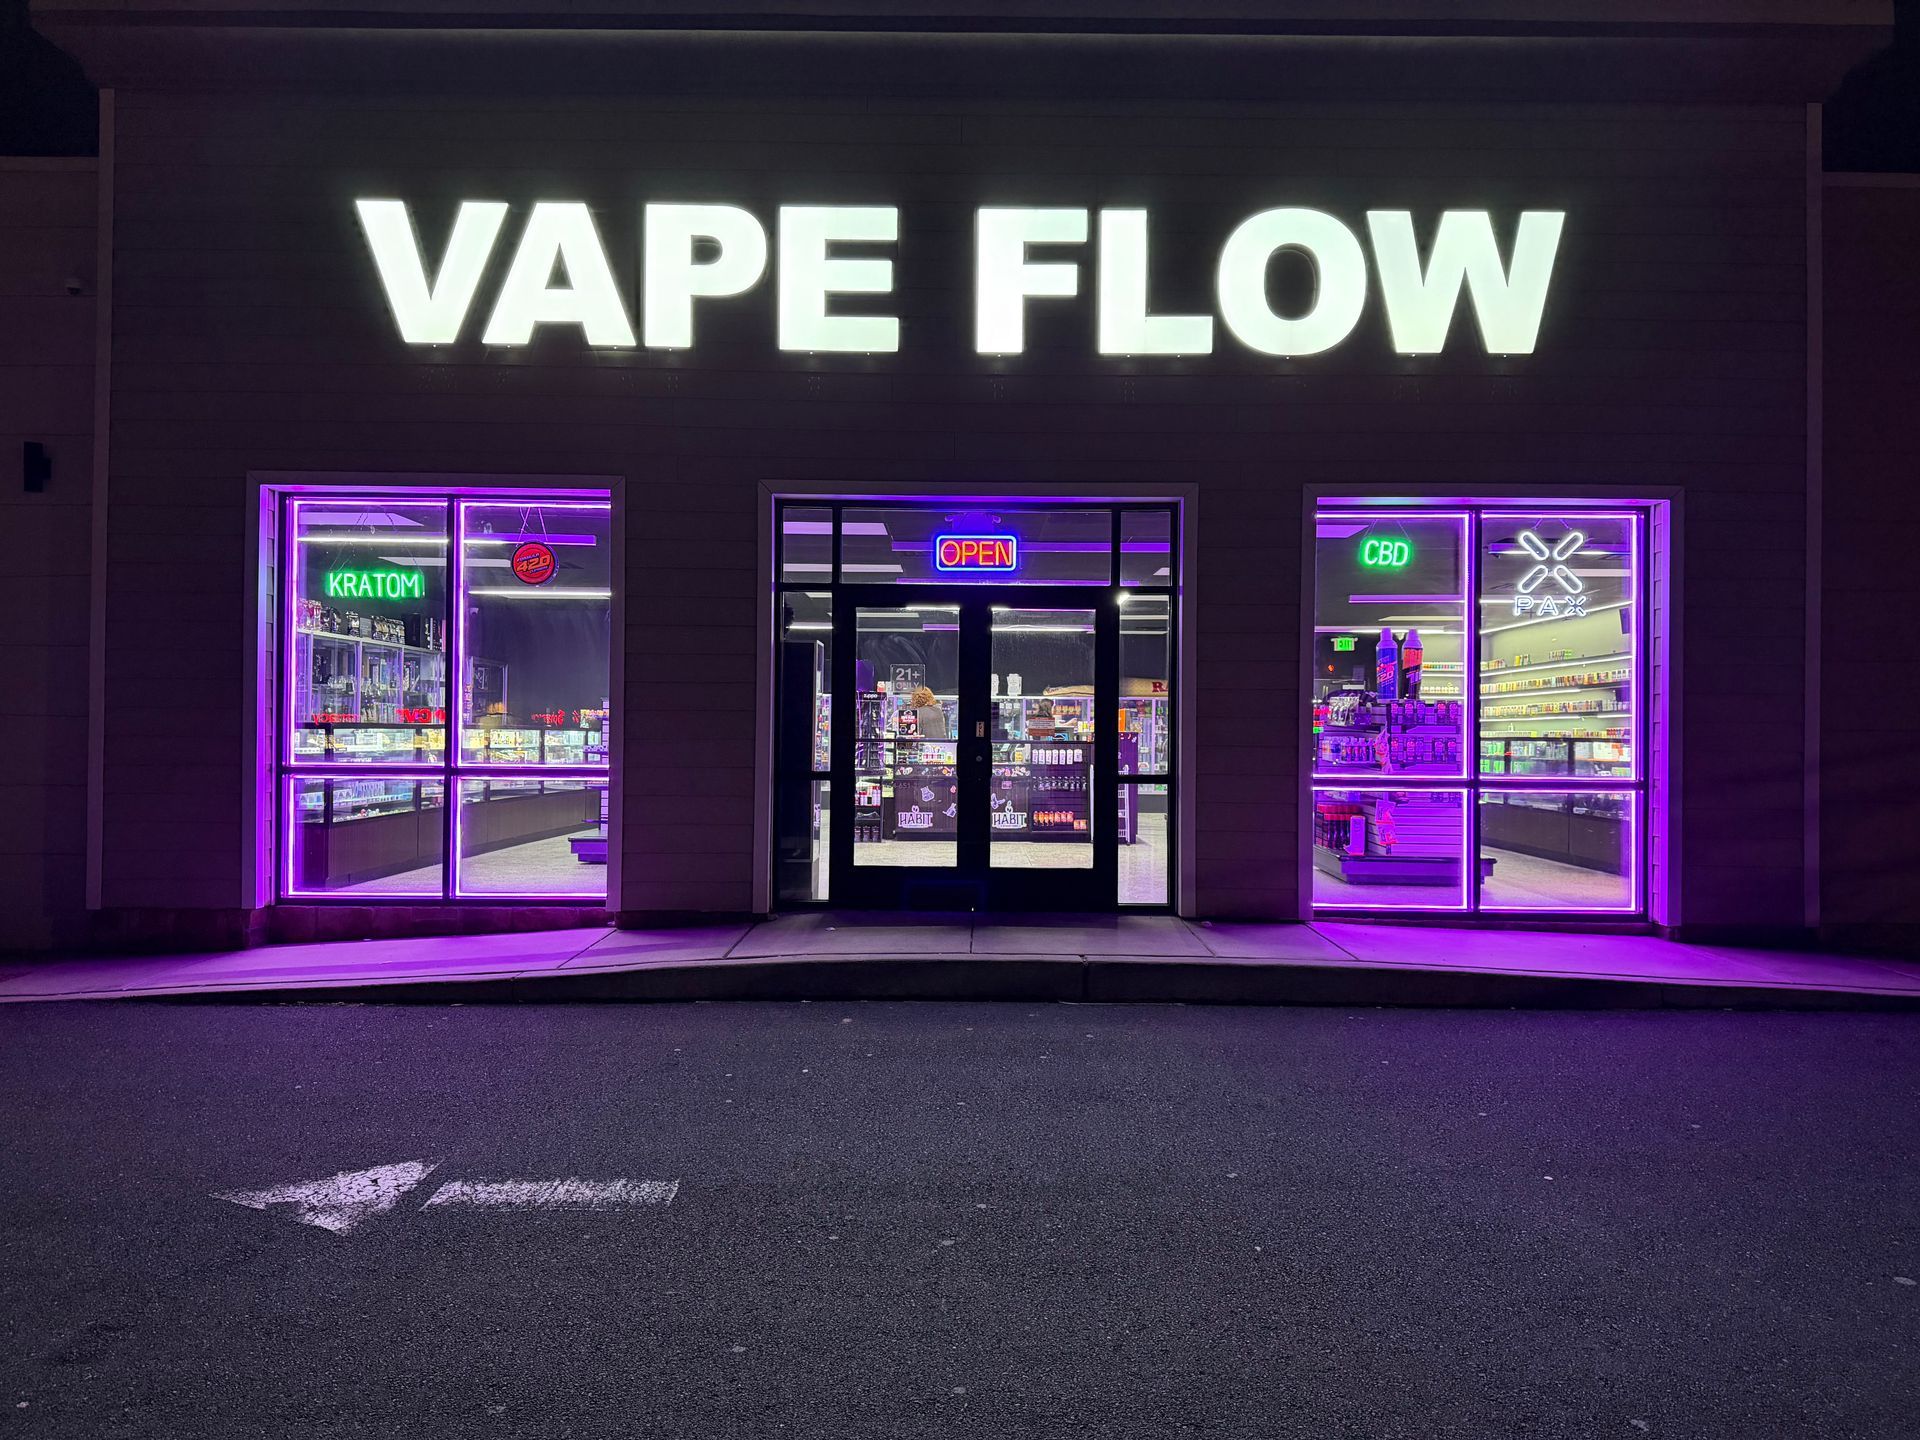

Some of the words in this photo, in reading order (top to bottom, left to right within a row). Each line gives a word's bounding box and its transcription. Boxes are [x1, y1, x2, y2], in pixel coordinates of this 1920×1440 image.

[354, 199, 900, 353] VAPE
[974, 206, 1567, 356] FLOW
[940, 540, 1013, 566] OPEN
[1364, 540, 1409, 566] CBD
[516, 554, 551, 572] 420
[329, 573, 420, 597] KRATOM
[1513, 595, 1587, 616] PAX
[895, 667, 921, 681] 21+
[895, 681, 920, 690] ONLY
[899, 813, 932, 825] HABIT
[993, 813, 1026, 826] HABIT
